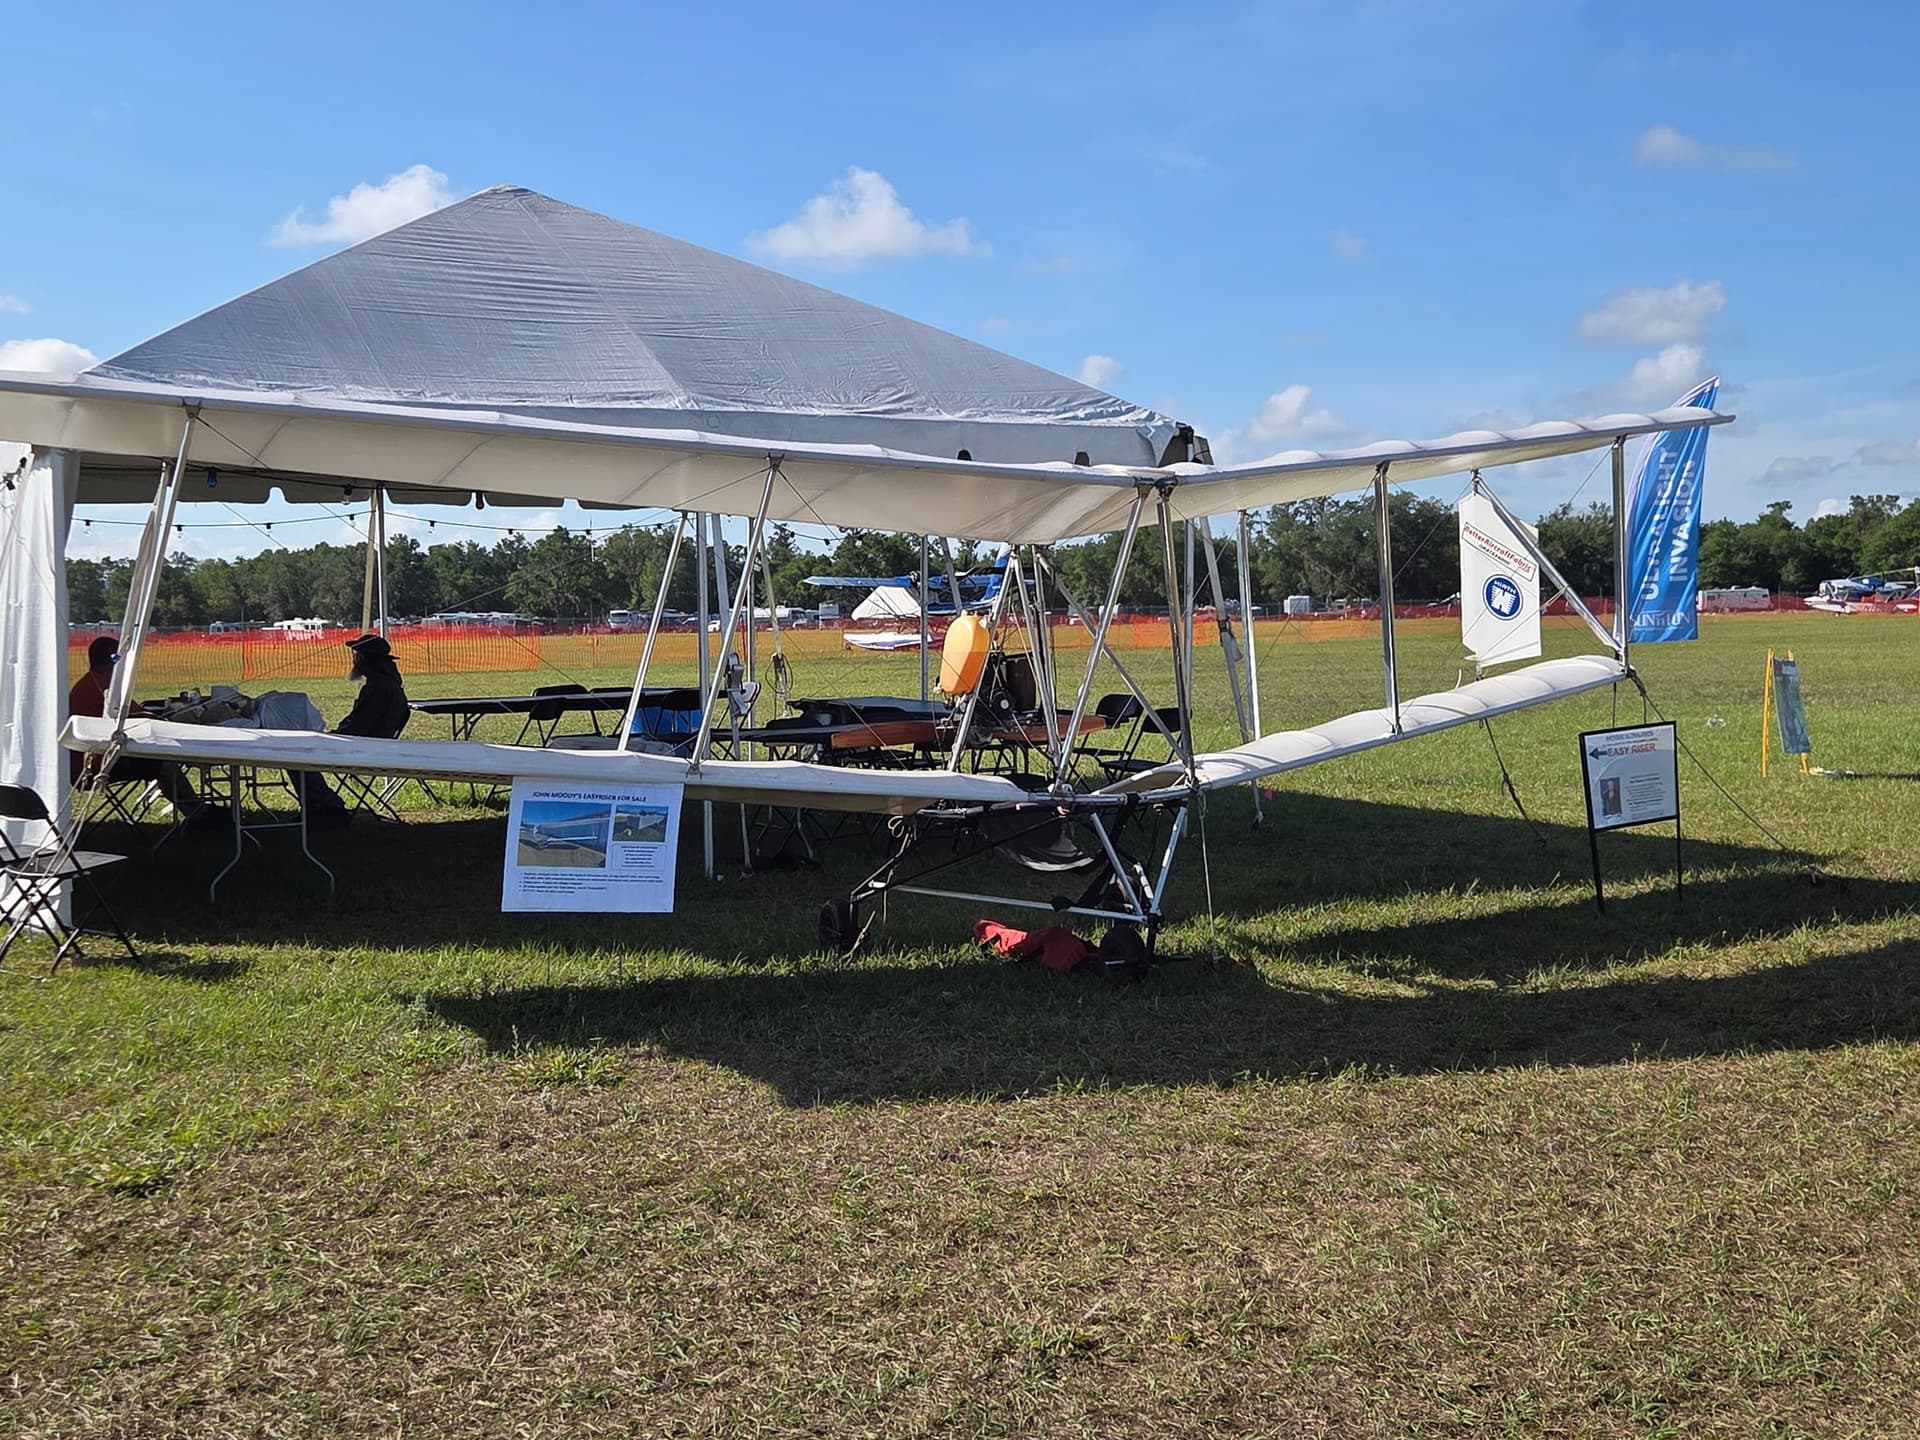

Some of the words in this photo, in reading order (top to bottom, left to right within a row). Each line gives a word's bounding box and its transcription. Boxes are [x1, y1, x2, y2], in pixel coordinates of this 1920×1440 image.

[1641, 447, 1678, 600] ULTRALIGHT
[1669, 459, 1696, 583] INVASION
[1494, 580, 1516, 594] HIRTH
[1607, 745, 1629, 757] EASY
[1631, 743, 1656, 755] RISER
[551, 792, 582, 800] MOODY'S
[583, 793, 615, 801] EASYRISER
